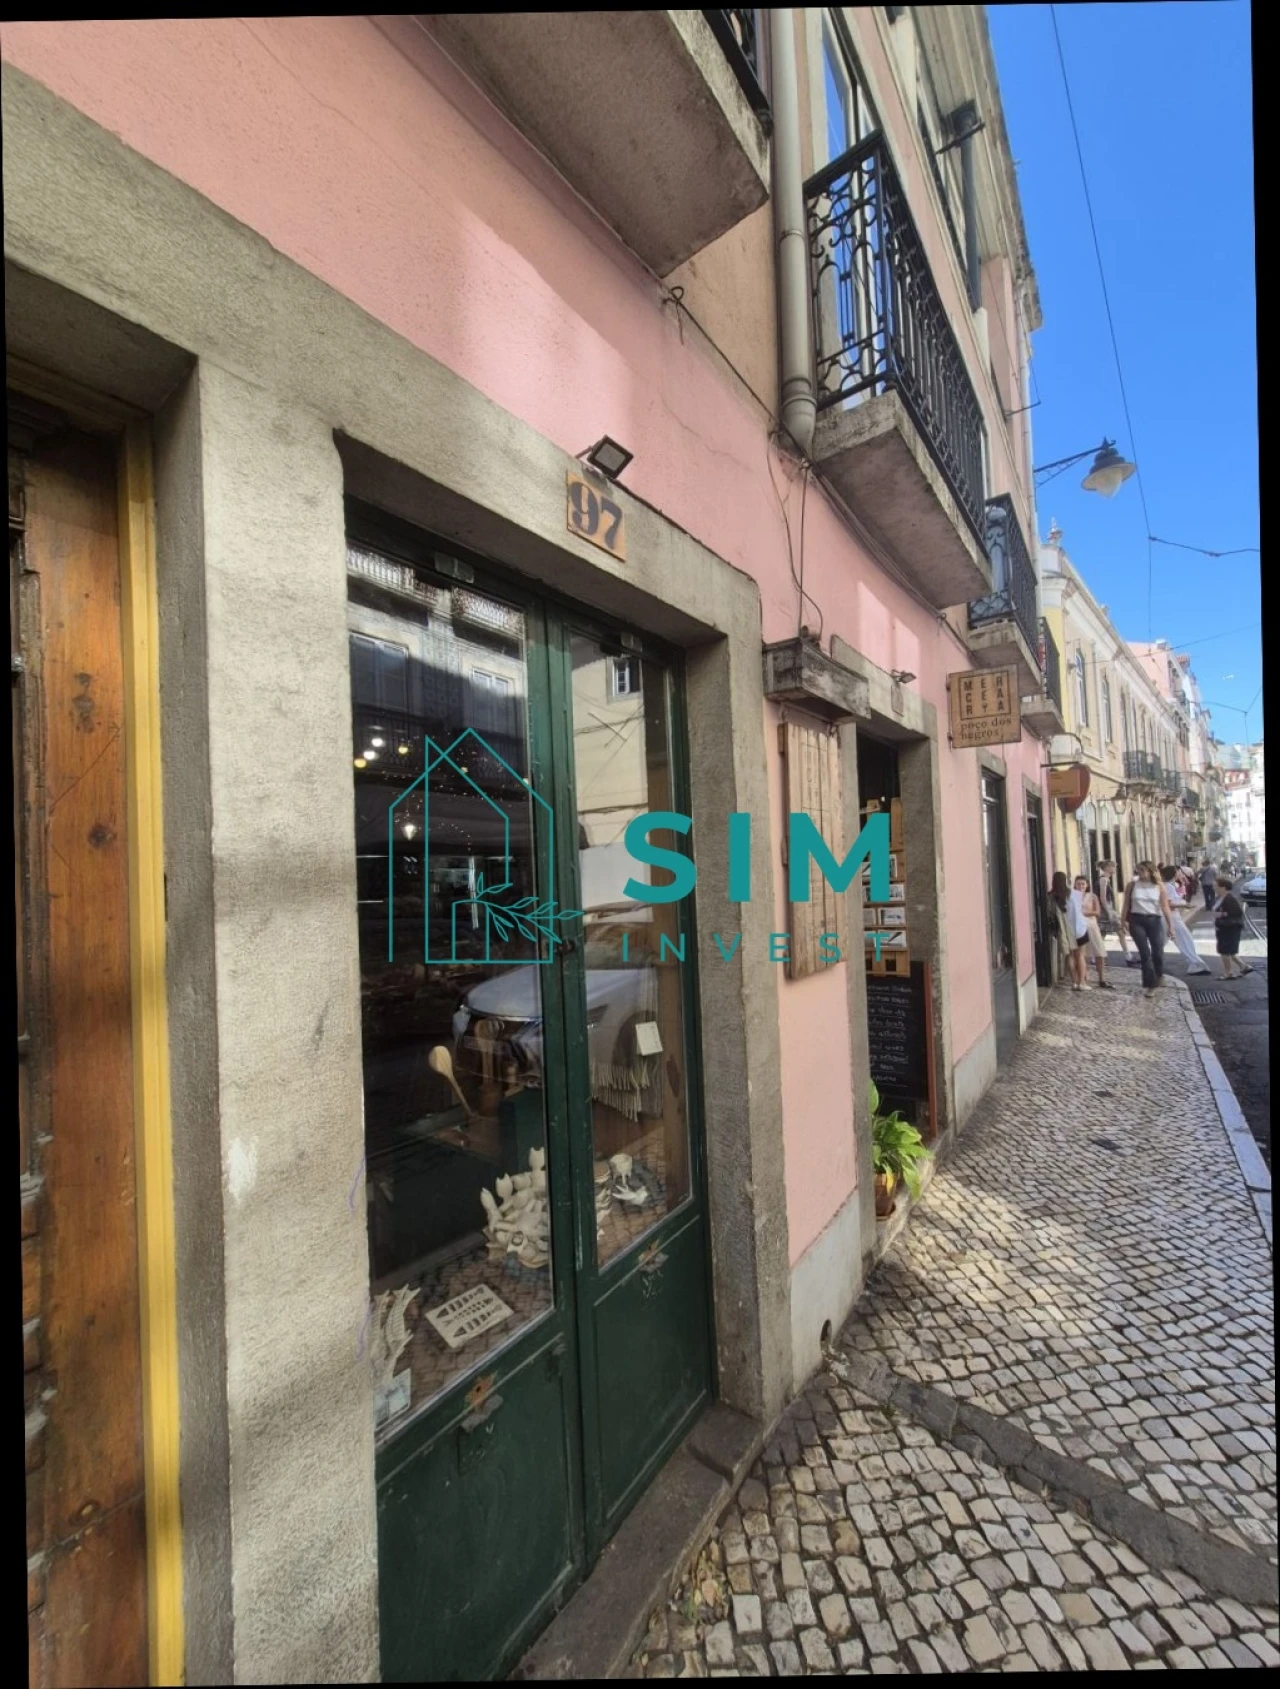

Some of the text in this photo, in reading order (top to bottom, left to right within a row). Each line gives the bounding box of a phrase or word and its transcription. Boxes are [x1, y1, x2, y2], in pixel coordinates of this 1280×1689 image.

[571, 482, 623, 550] 97
[961, 717, 1012, 733] poço dos
[961, 729, 999, 740] negros
